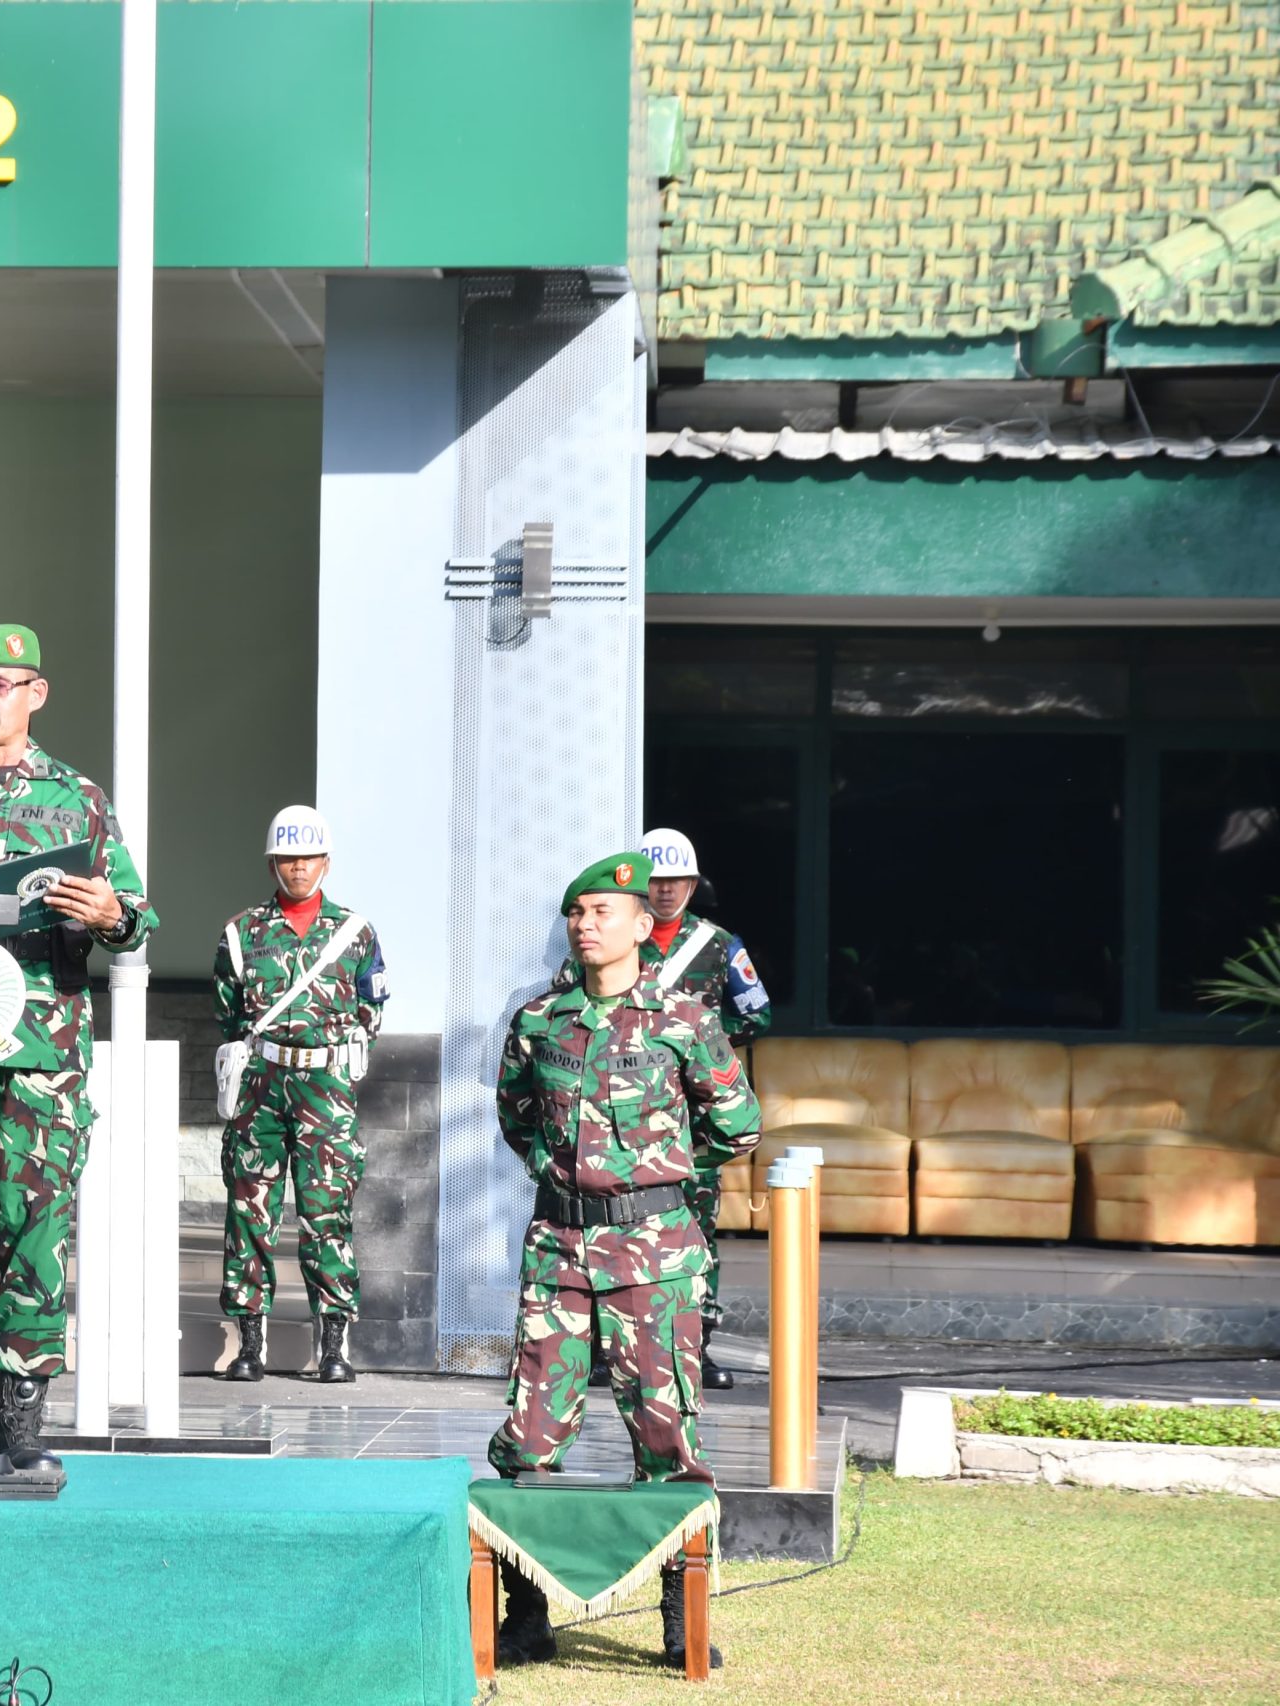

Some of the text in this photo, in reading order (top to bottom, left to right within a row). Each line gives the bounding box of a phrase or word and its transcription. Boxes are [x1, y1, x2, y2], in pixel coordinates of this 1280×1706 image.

[20, 807, 44, 819] TNI
[276, 824, 324, 847] PROV
[616, 1056, 638, 1069] TNI
